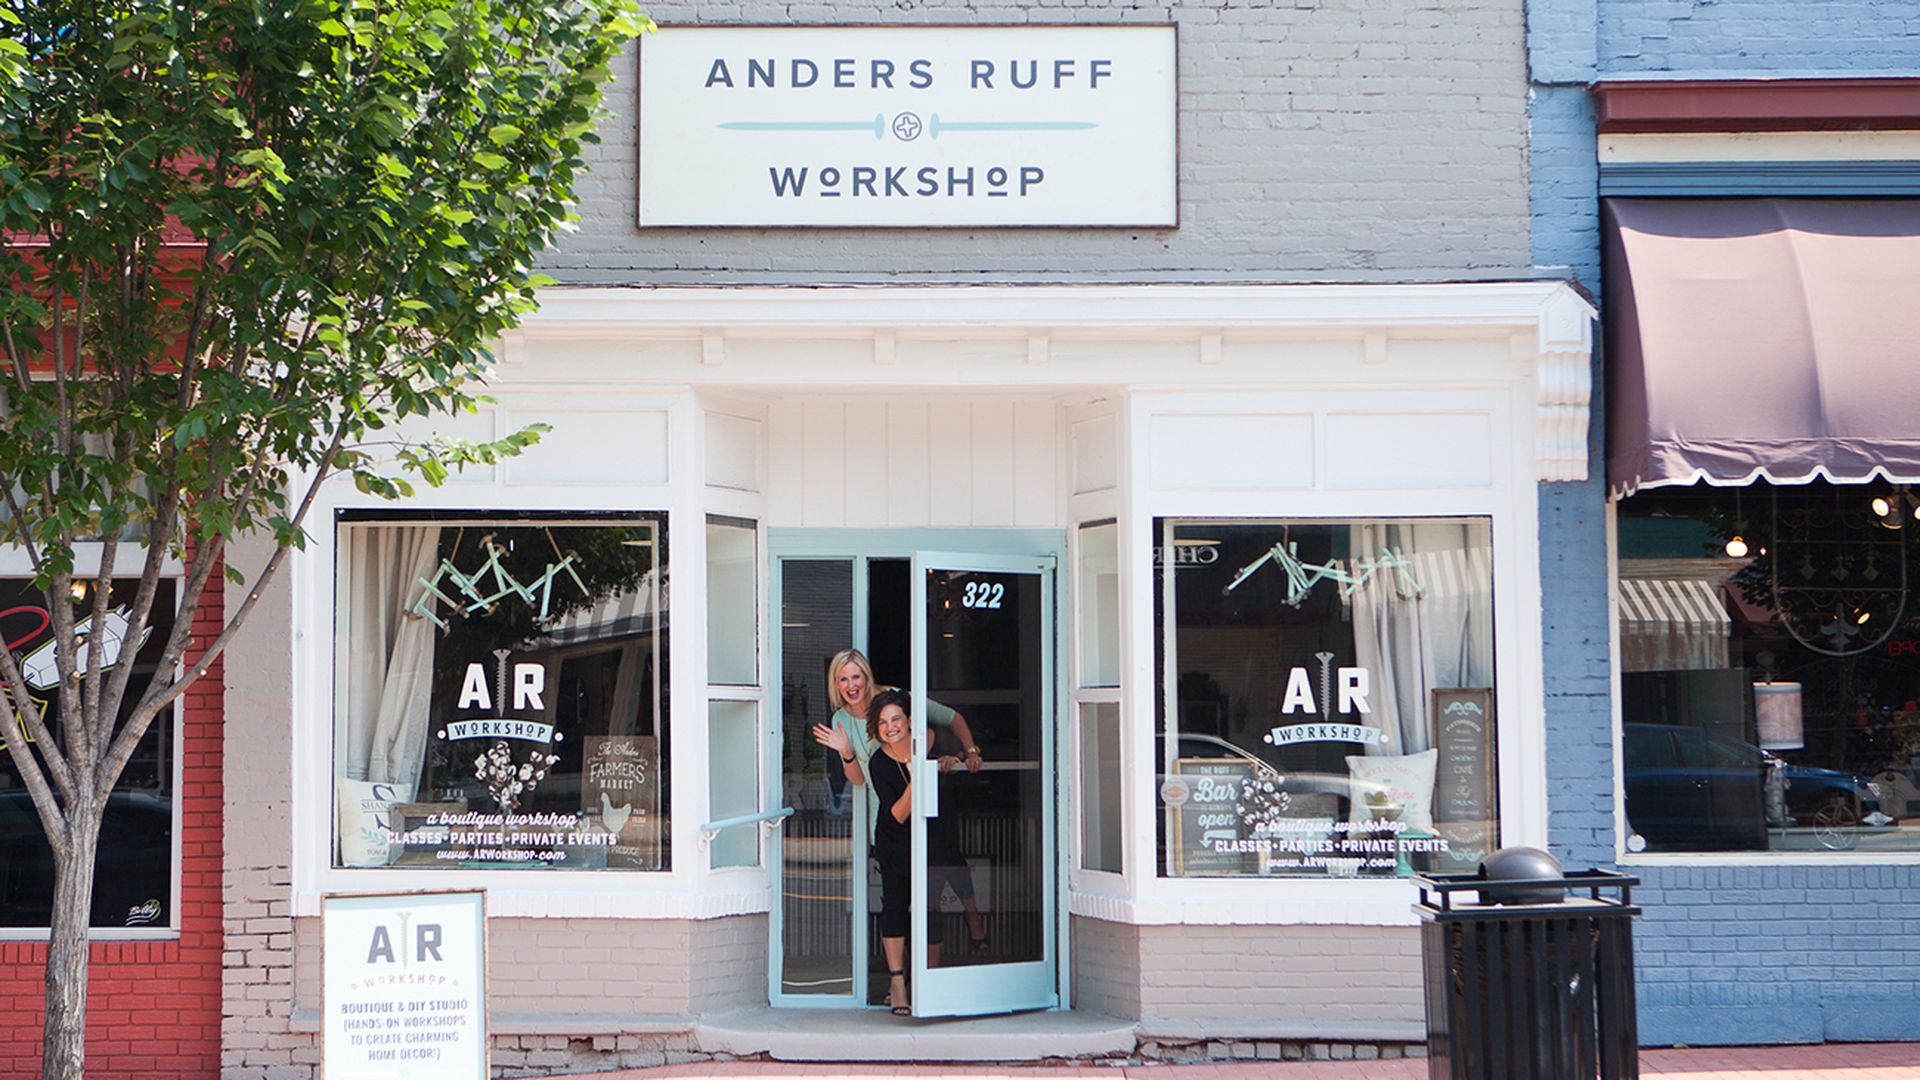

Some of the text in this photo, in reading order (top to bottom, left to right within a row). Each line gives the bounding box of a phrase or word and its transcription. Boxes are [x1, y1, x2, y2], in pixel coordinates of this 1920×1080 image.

[705, 59, 1112, 89] ANDERS RUFF
[769, 167, 1045, 197] WORKSHOP
[962, 581, 1004, 608] 322
[454, 722, 546, 738] WORKSHOP
[1279, 726, 1373, 741] WORKSHOP
[590, 762, 645, 784] FARMERS
[1193, 776, 1239, 802] Bar
[427, 814, 439, 825] a
[440, 812, 503, 829] boutique
[505, 812, 578, 828] workshop
[1198, 813, 1237, 829] open
[1255, 817, 1407, 835] a boutique workshop
[387, 832, 617, 846] CLASSES PARTIES PRIVATE EVENTS
[1215, 840, 1449, 853] CLASSES PARTIES PRIVATE EVENTS
[363, 973, 447, 989] WORKSHOP
[341, 999, 468, 1014] BOUTIQUE & DIY STUDIO
[404, 1015, 466, 1028] WORKSHOPS
[350, 1031, 459, 1046] TO CREATE CHARMING
[368, 1049, 397, 1061] HOME
